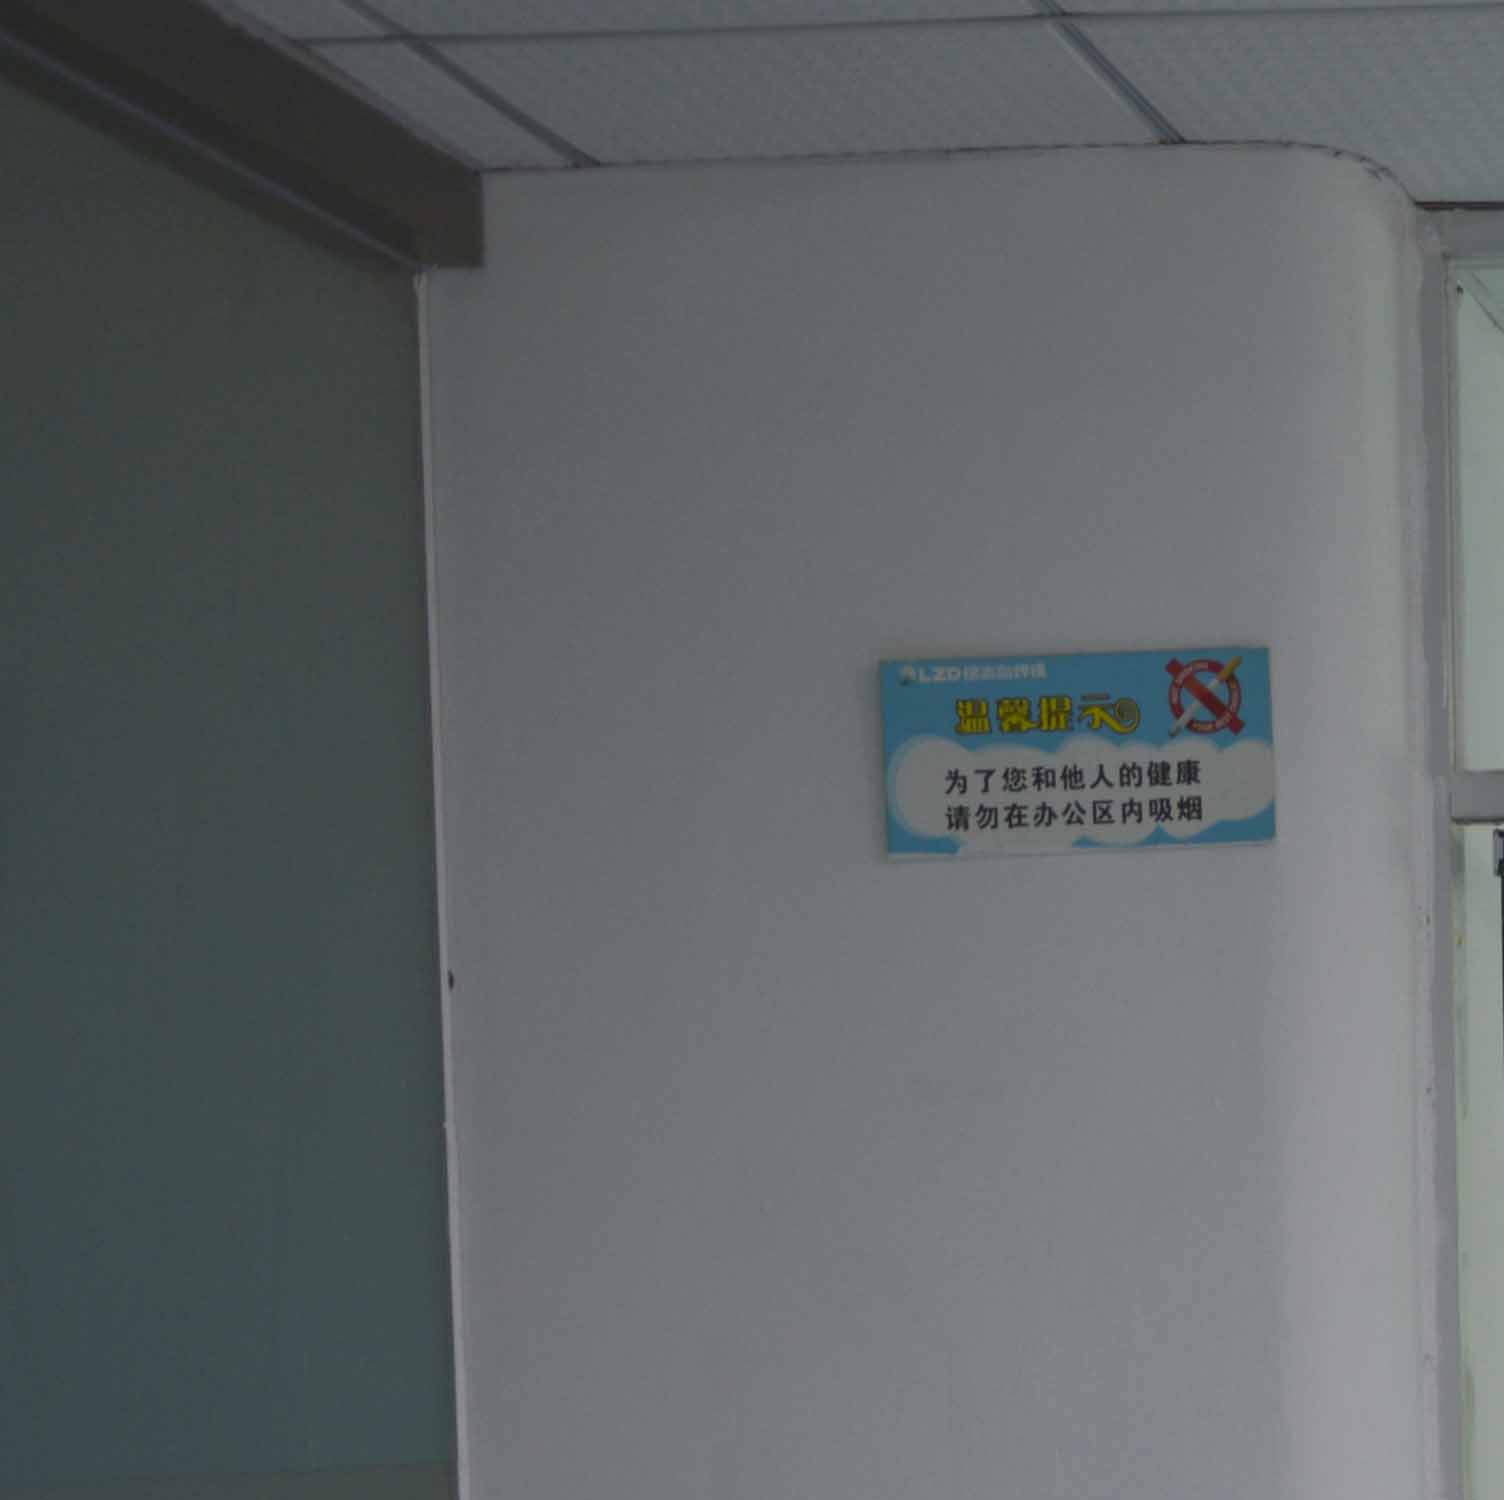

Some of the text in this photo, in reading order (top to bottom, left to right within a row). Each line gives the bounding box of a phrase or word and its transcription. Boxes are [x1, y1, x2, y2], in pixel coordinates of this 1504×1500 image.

[954, 693, 1140, 733] 温馨提示
[945, 758, 1201, 795] 为了您和他人的健康
[945, 795, 1203, 831] 请勿在办公区内吸烟
